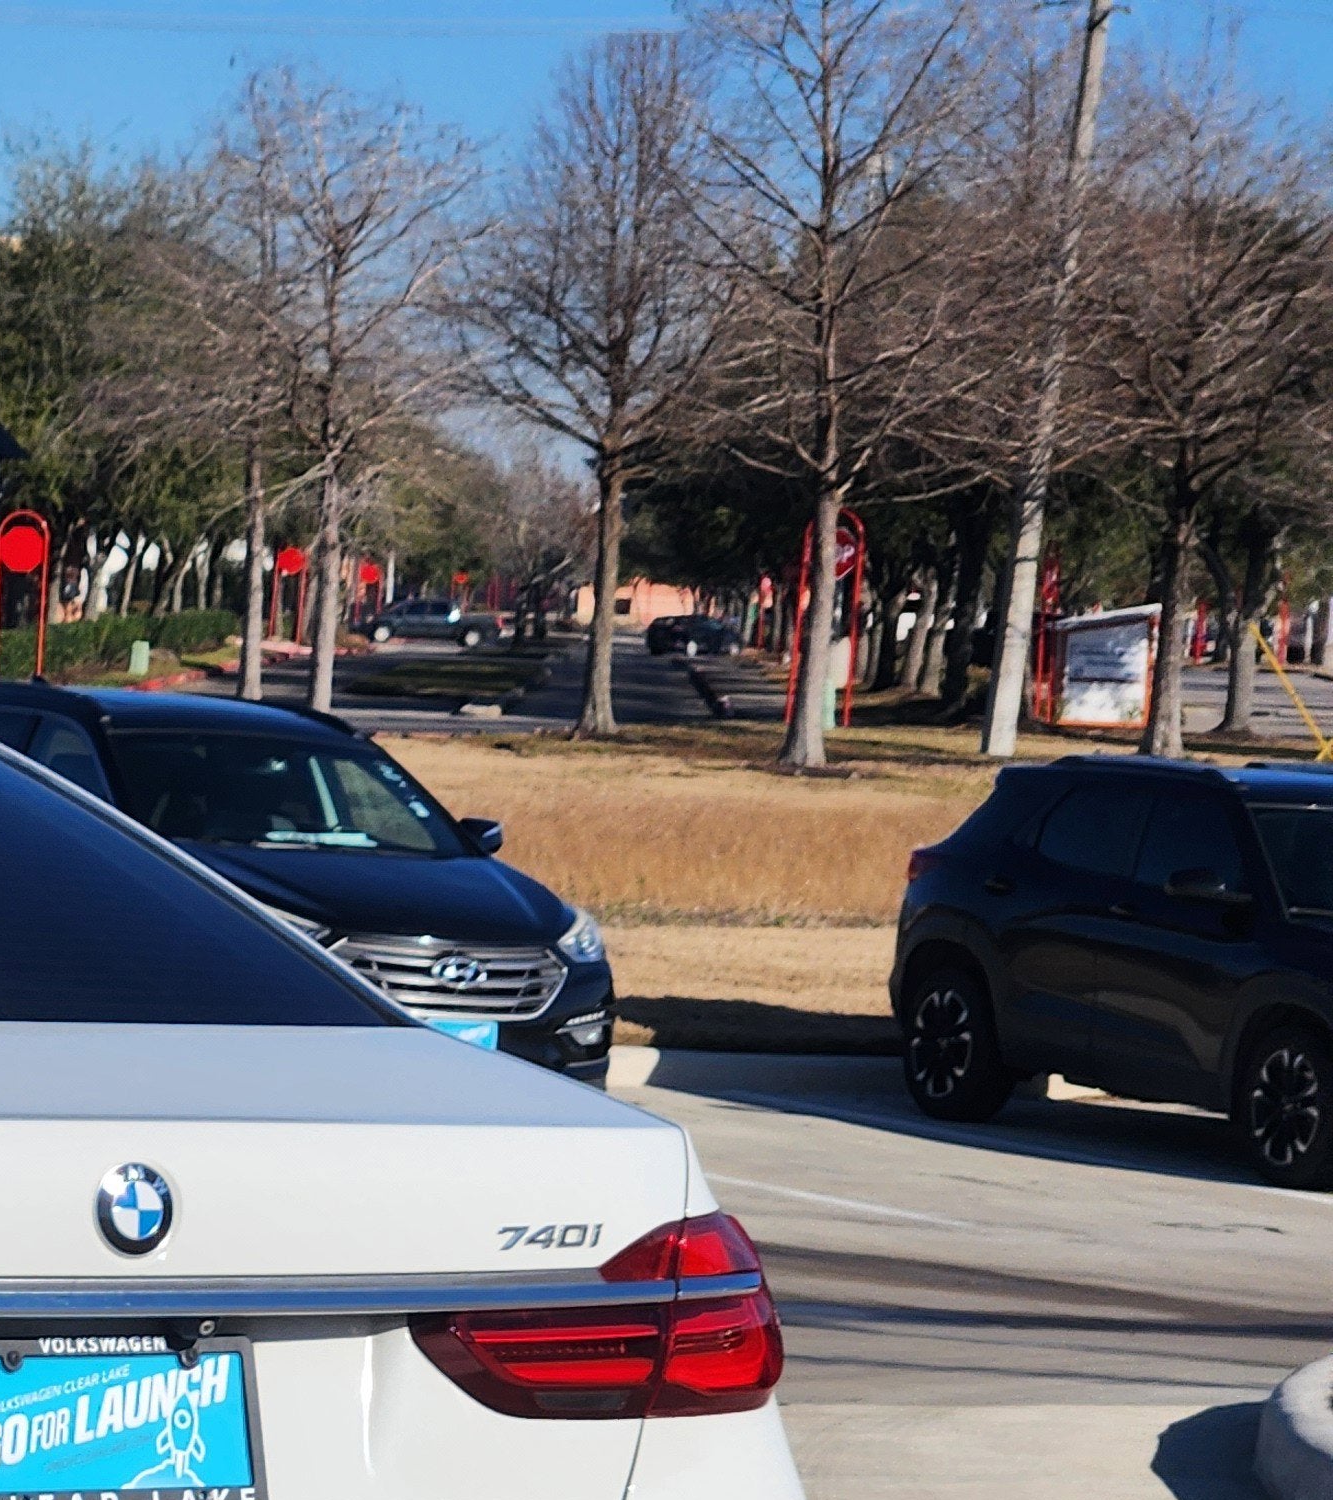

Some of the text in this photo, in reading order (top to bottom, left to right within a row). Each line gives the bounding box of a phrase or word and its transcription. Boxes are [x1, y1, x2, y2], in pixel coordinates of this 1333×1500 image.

[497, 1222, 604, 1251] 740i
[38, 1336, 167, 1355] VOLKSWAGEN
[62, 1372, 100, 1394] CLEAR
[101, 1363, 131, 1383] LAKE
[30, 1407, 70, 1454] FOR
[73, 1354, 231, 1446] LAUNCH
